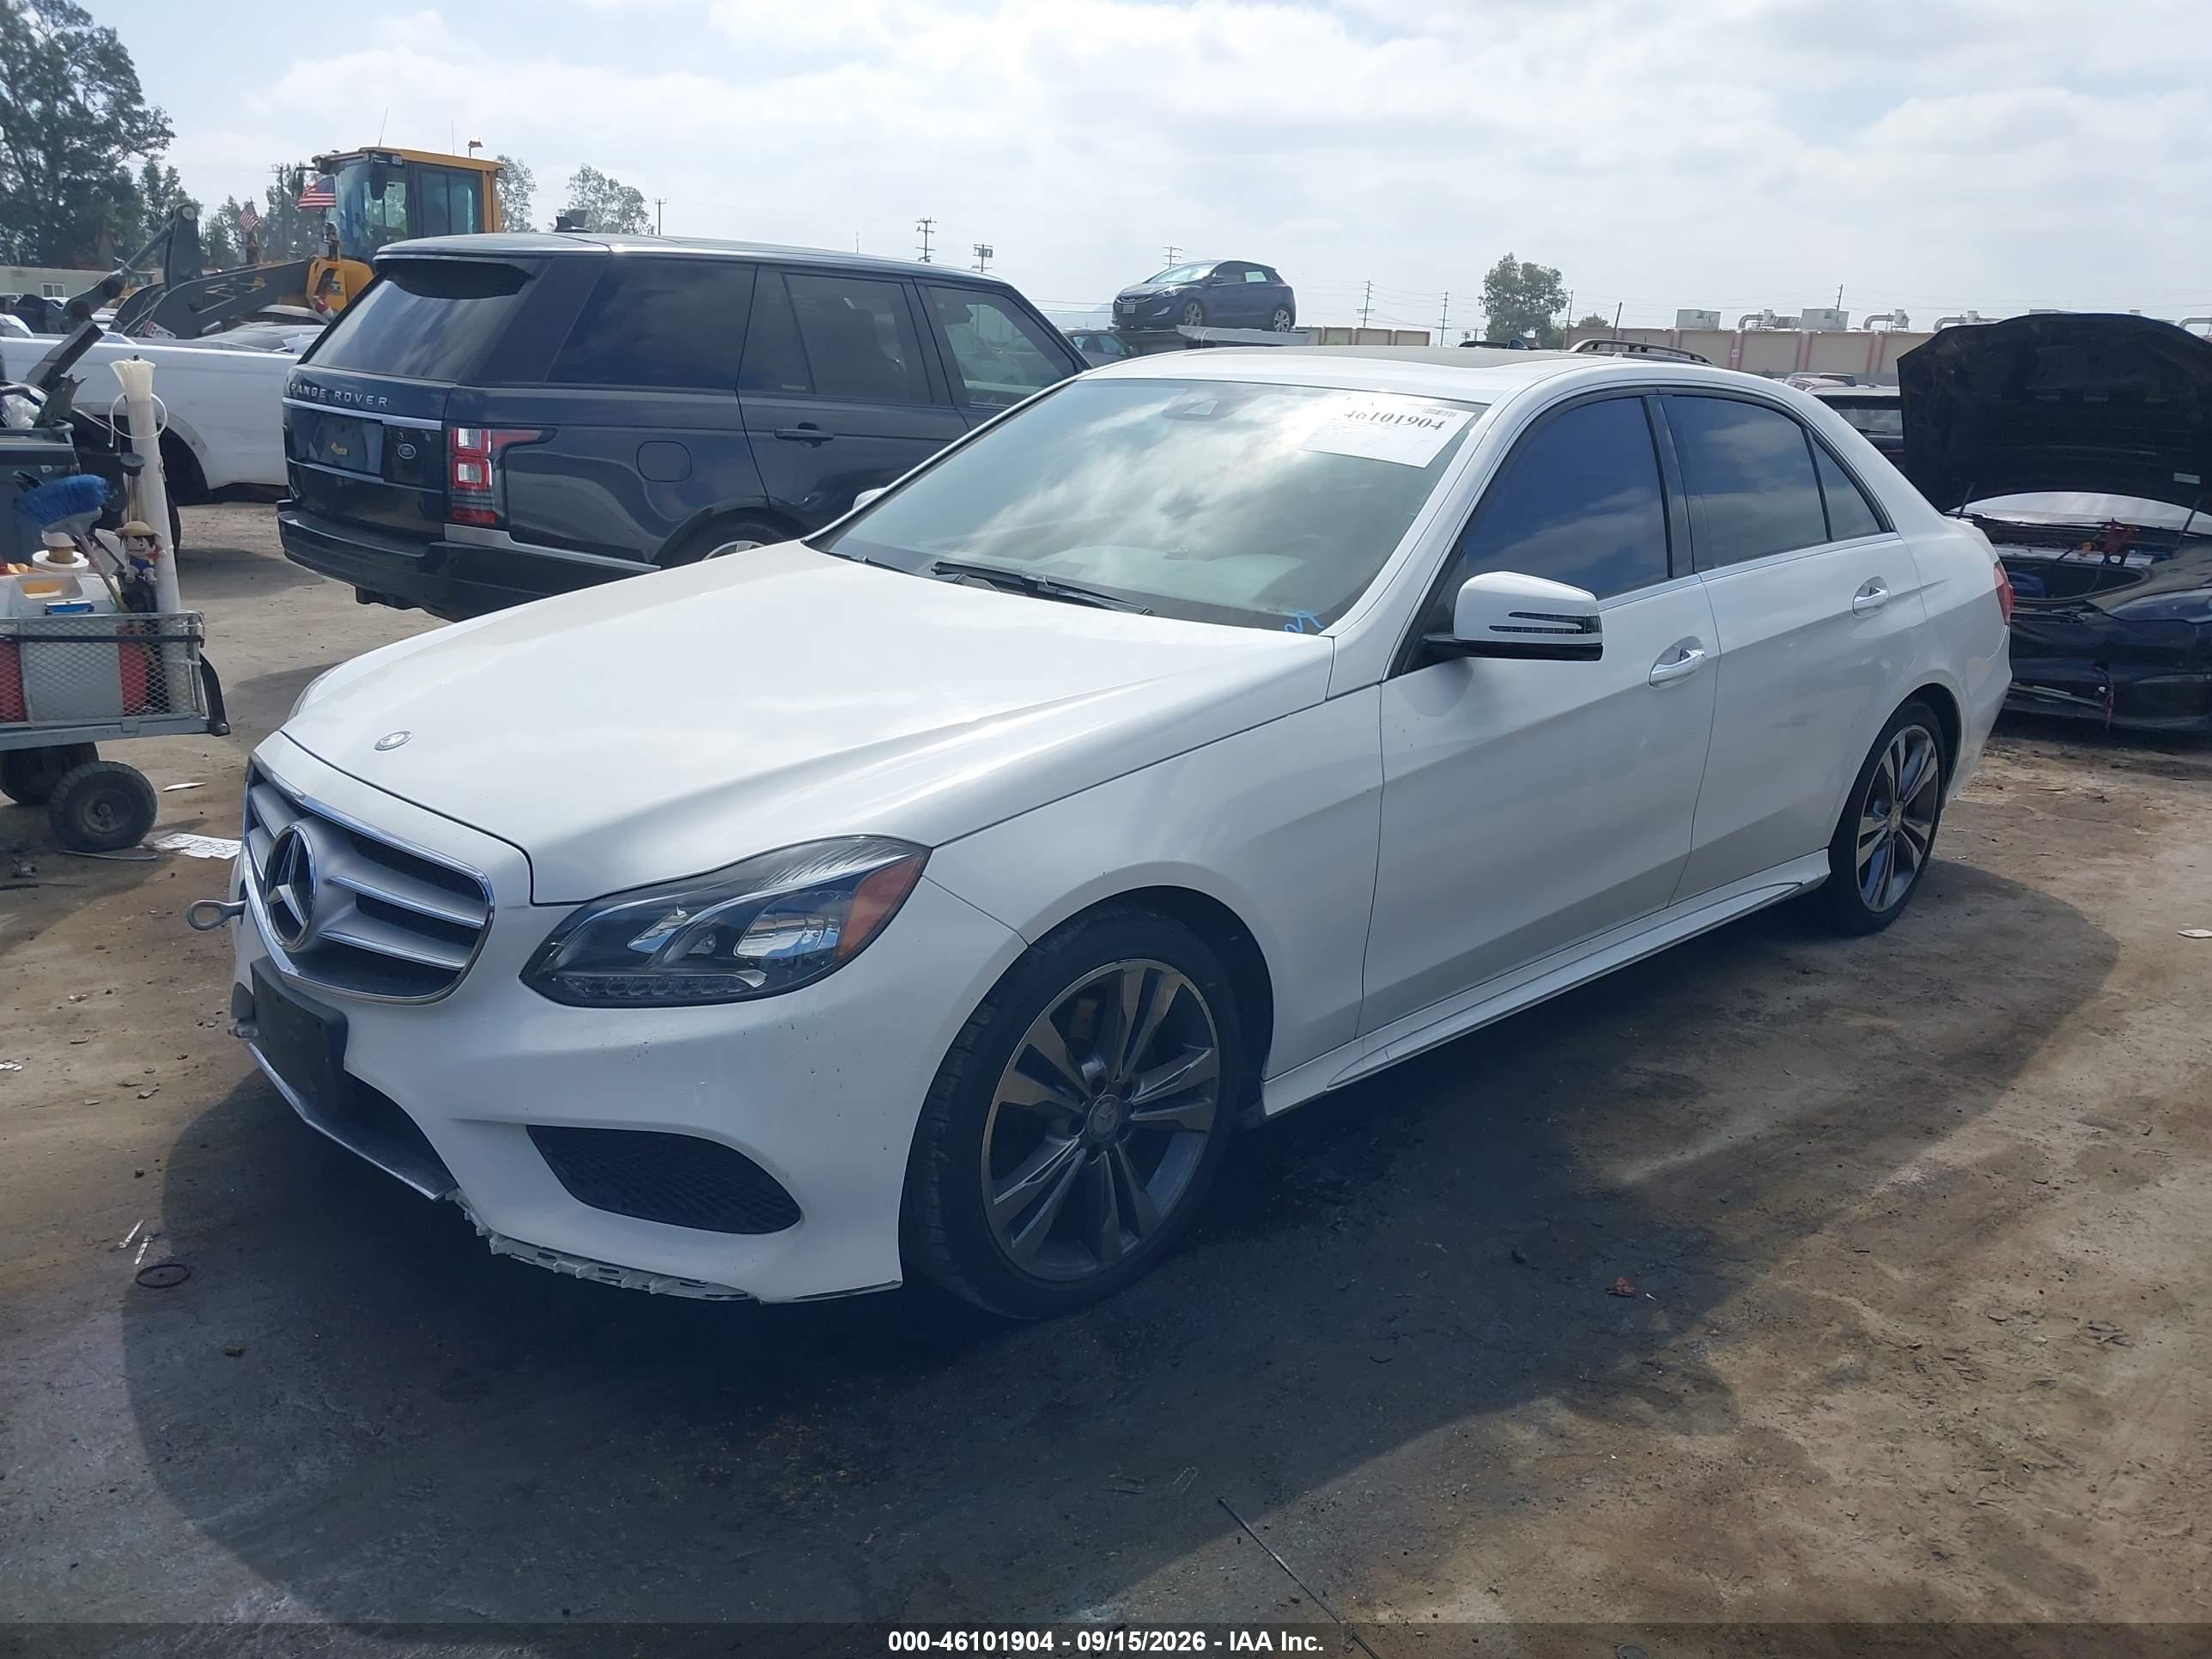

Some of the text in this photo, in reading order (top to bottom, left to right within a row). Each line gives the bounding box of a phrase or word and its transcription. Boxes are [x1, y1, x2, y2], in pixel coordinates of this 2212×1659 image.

[290, 383, 388, 407] RANGE ROVER
[1343, 410, 1446, 430] 46101904
